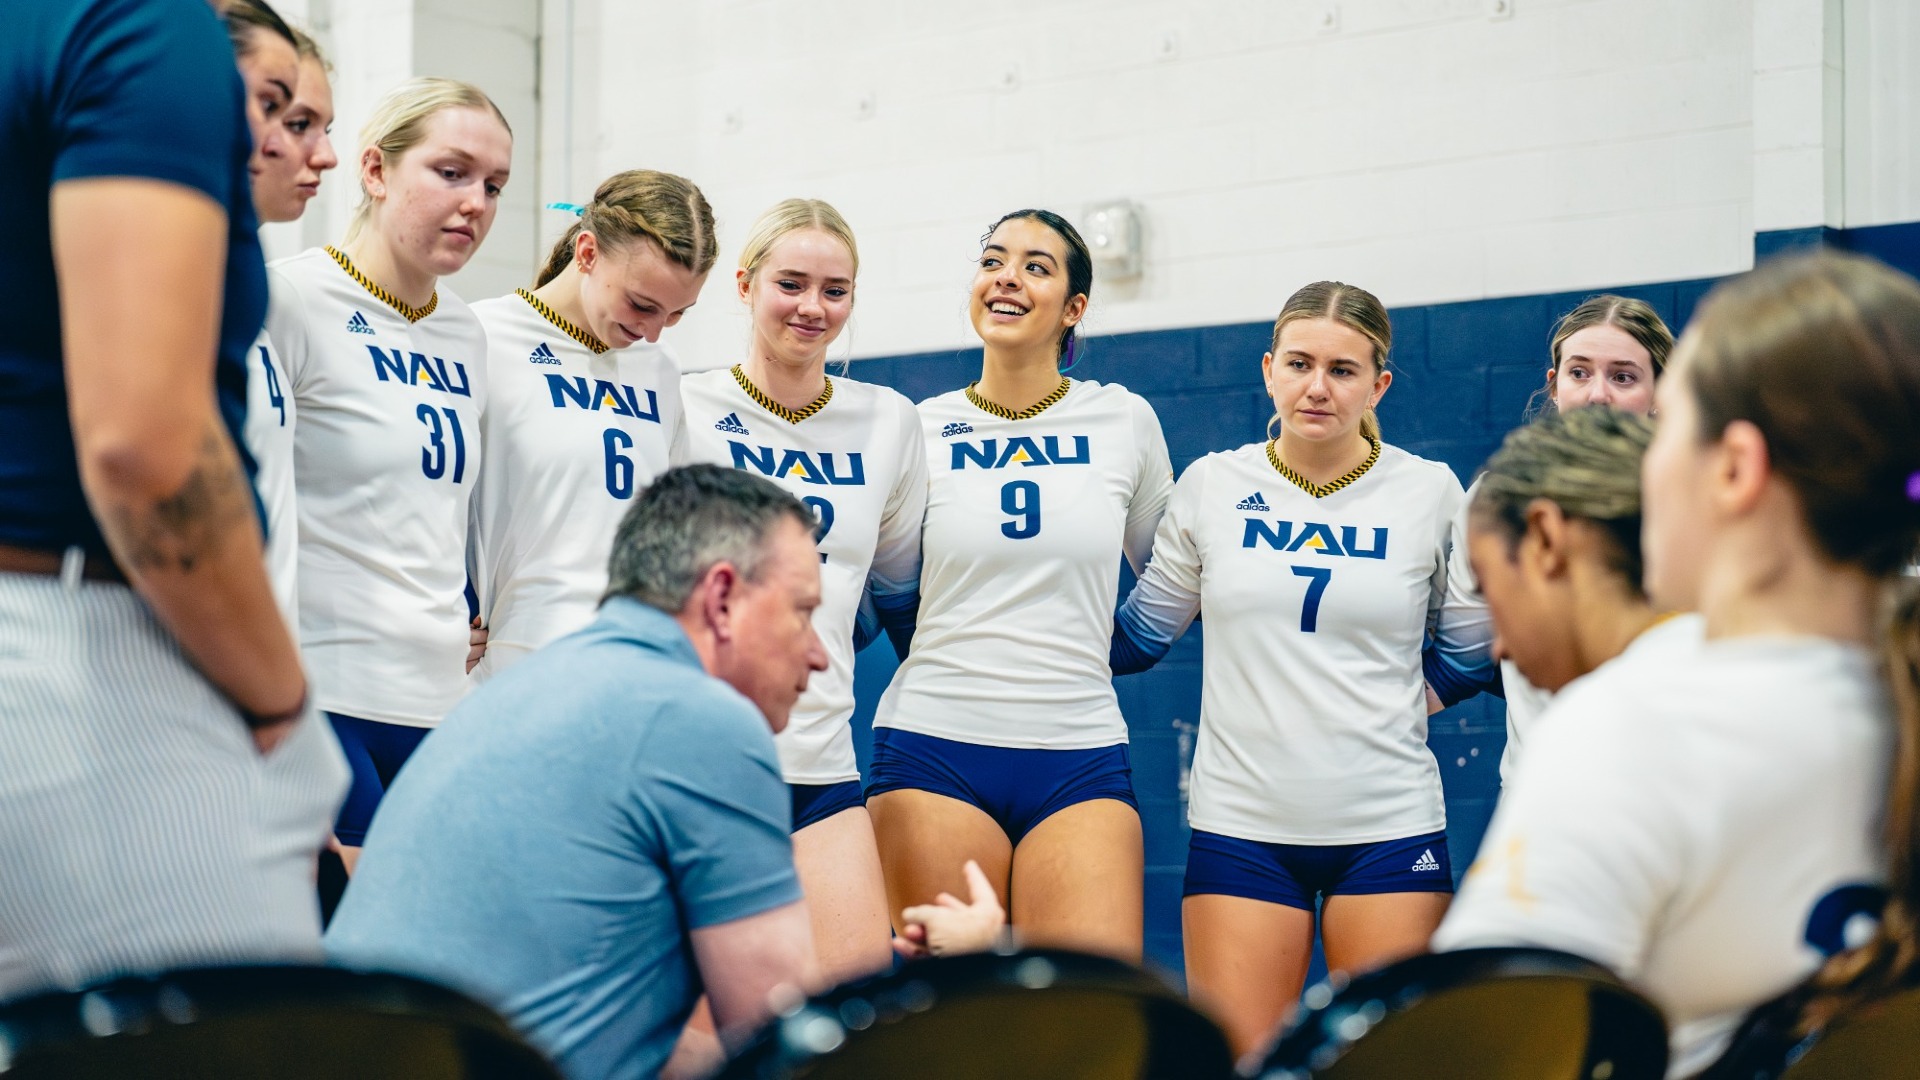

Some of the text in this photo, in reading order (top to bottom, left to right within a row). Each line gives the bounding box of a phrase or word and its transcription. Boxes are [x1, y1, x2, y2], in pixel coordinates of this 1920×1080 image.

[365, 345, 471, 397] NAU
[529, 355, 562, 366] adidas
[258, 345, 285, 427] 4
[543, 373, 661, 424] NAU
[416, 403, 466, 484] 31
[714, 423, 750, 435] adidas
[941, 423, 974, 438] adidas
[602, 428, 634, 500] 6
[727, 440, 866, 486] NAU
[950, 435, 1091, 470] NAU
[1000, 480, 1041, 540] 9
[1236, 502, 1271, 512] adidas
[1242, 518, 1389, 560] NAU
[1290, 565, 1332, 633] 7
[1411, 862, 1440, 872] adidas
